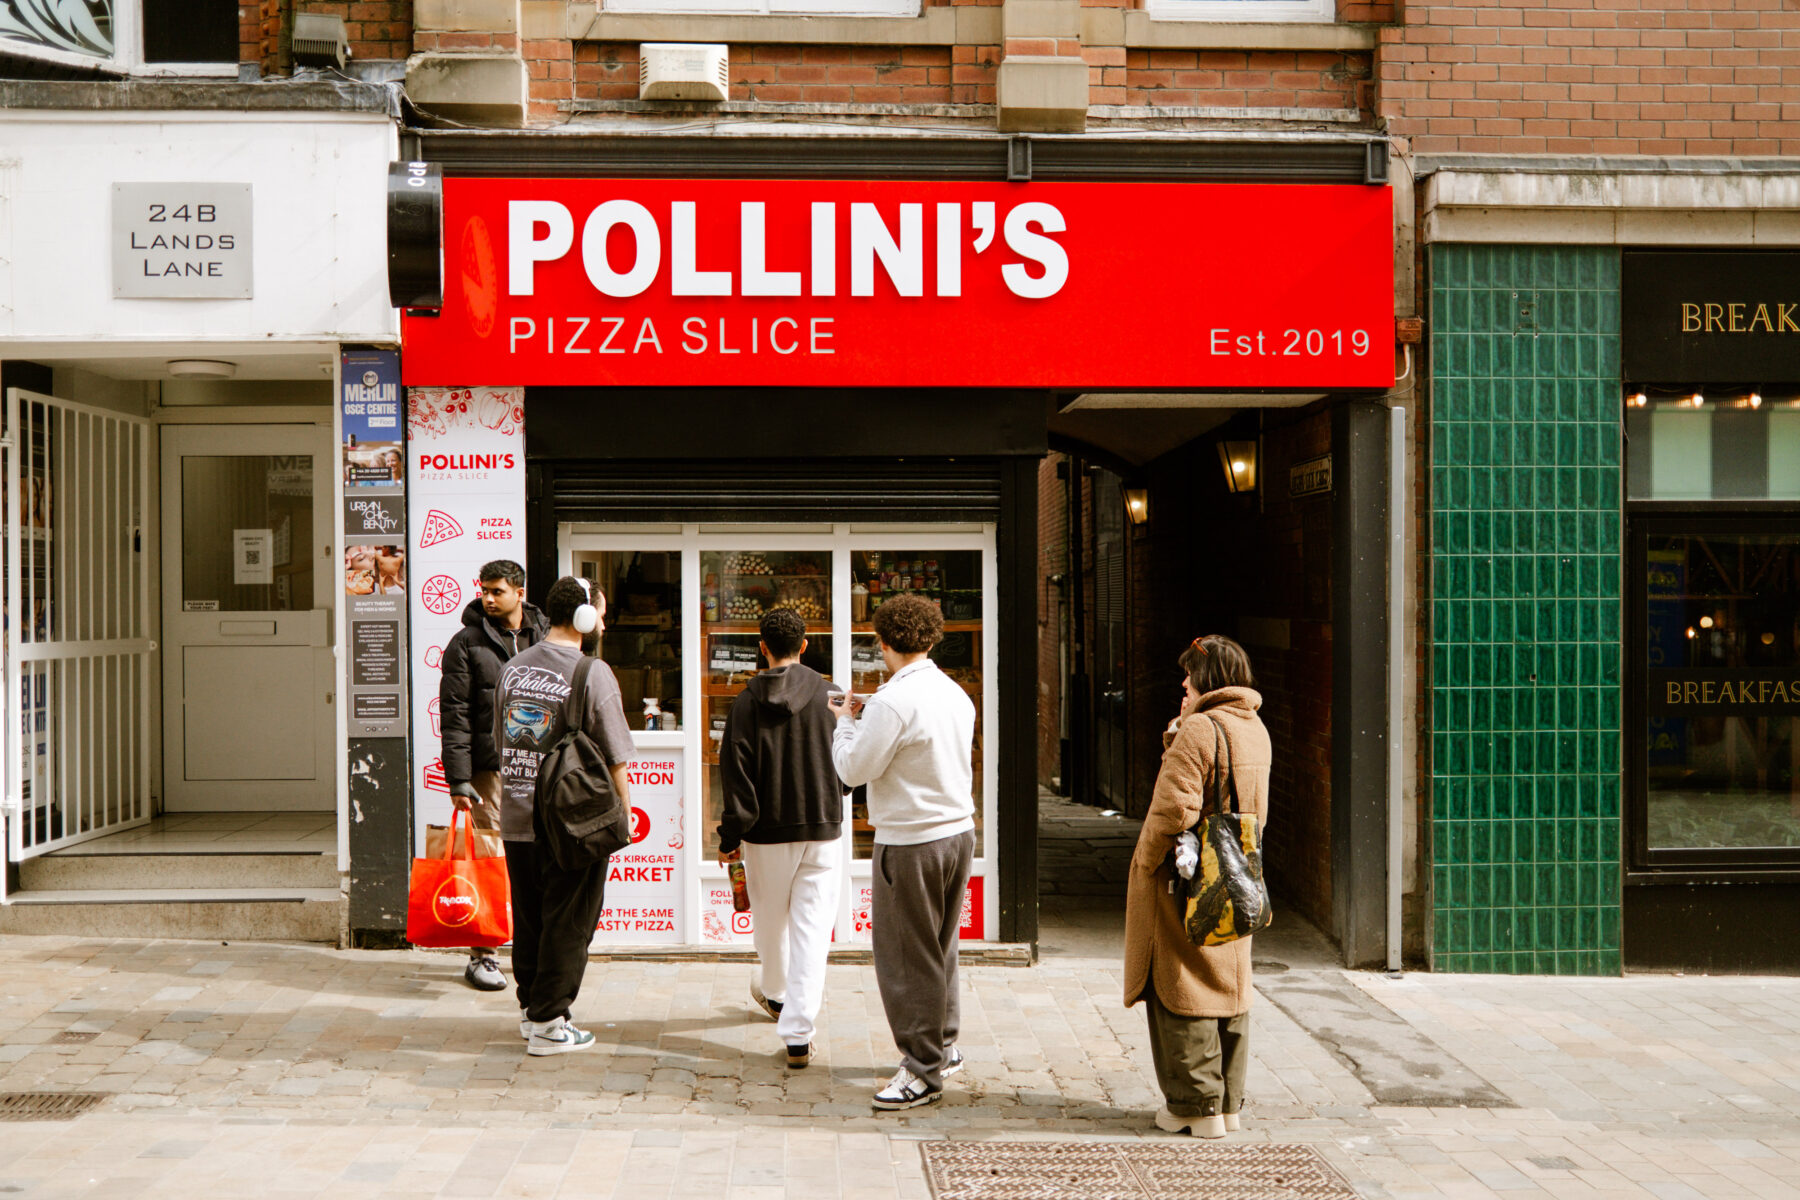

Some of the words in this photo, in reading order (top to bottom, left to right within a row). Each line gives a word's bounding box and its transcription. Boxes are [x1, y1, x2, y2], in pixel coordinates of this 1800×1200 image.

[148, 204, 216, 222] 24B
[131, 231, 235, 249] LANDS
[508, 199, 1069, 299] POLLINI'S
[144, 259, 223, 277] LANE
[1681, 303, 1800, 332] BREAK
[510, 317, 663, 354] PIZZA
[681, 317, 835, 354] SLICE
[344, 383, 397, 402] MERLIN
[344, 403, 366, 415] OSCE
[367, 403, 397, 415] CENTRE
[419, 453, 515, 470] POLLINI'S
[458, 472, 489, 480] SLICE
[350, 501, 381, 515] URBAN
[365, 510, 389, 520] CHIC
[363, 519, 398, 533] BEAUTY
[480, 518, 512, 527] PIZZA
[477, 531, 513, 540] SLICES
[501, 766, 523, 776] ONT
[641, 761, 675, 770] OTHER
[627, 772, 674, 785] ATION
[624, 855, 675, 863] KIRKGATE
[609, 867, 675, 882] ARKET
[710, 890, 732, 898] FOLL
[600, 908, 613, 918] OR
[616, 908, 638, 918] THE
[641, 908, 675, 918] SAME
[596, 920, 631, 931] ASTY
[635, 920, 675, 931] PIZZA
